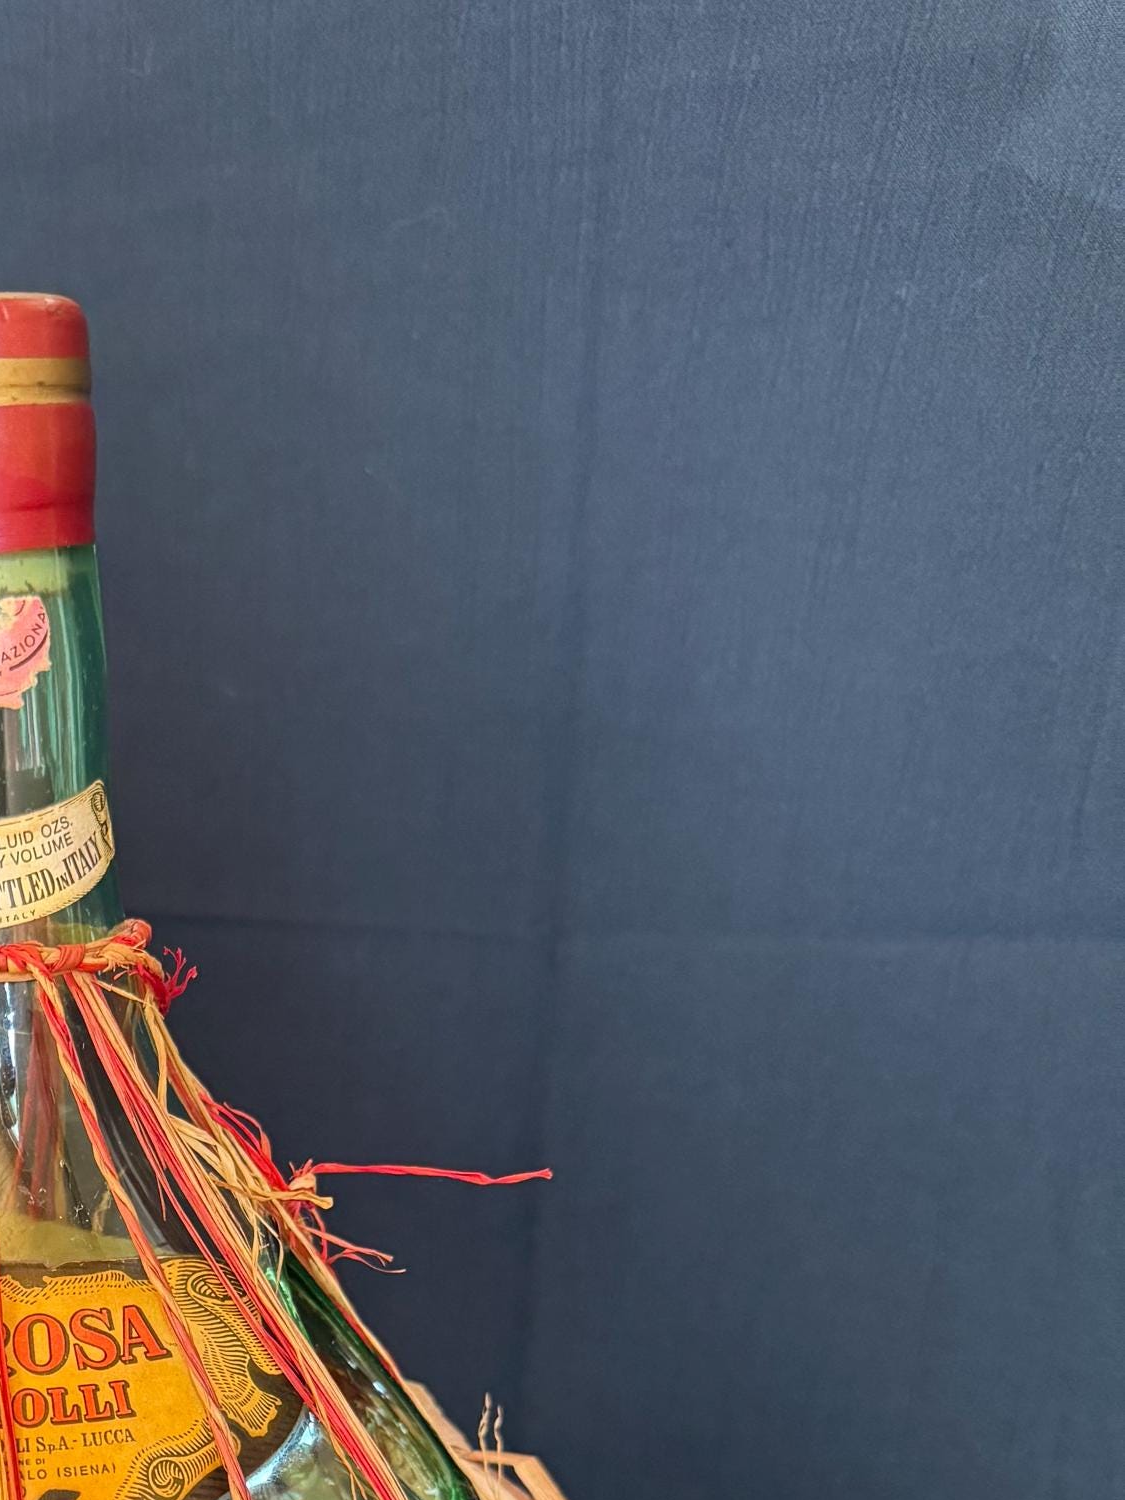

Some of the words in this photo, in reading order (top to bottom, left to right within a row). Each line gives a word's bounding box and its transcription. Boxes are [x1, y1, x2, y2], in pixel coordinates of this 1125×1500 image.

[40, 815, 74, 839] OZS.
[10, 831, 74, 866] VOLUME
[62, 830, 102, 885] ITALY
[56, 872, 70, 891] IN
[0, 909, 36, 924] ITALY
[81, 1428, 136, 1448] LUCCA
[35, 1458, 46, 1466] DI
[57, 1462, 116, 1478] (SIENA)
